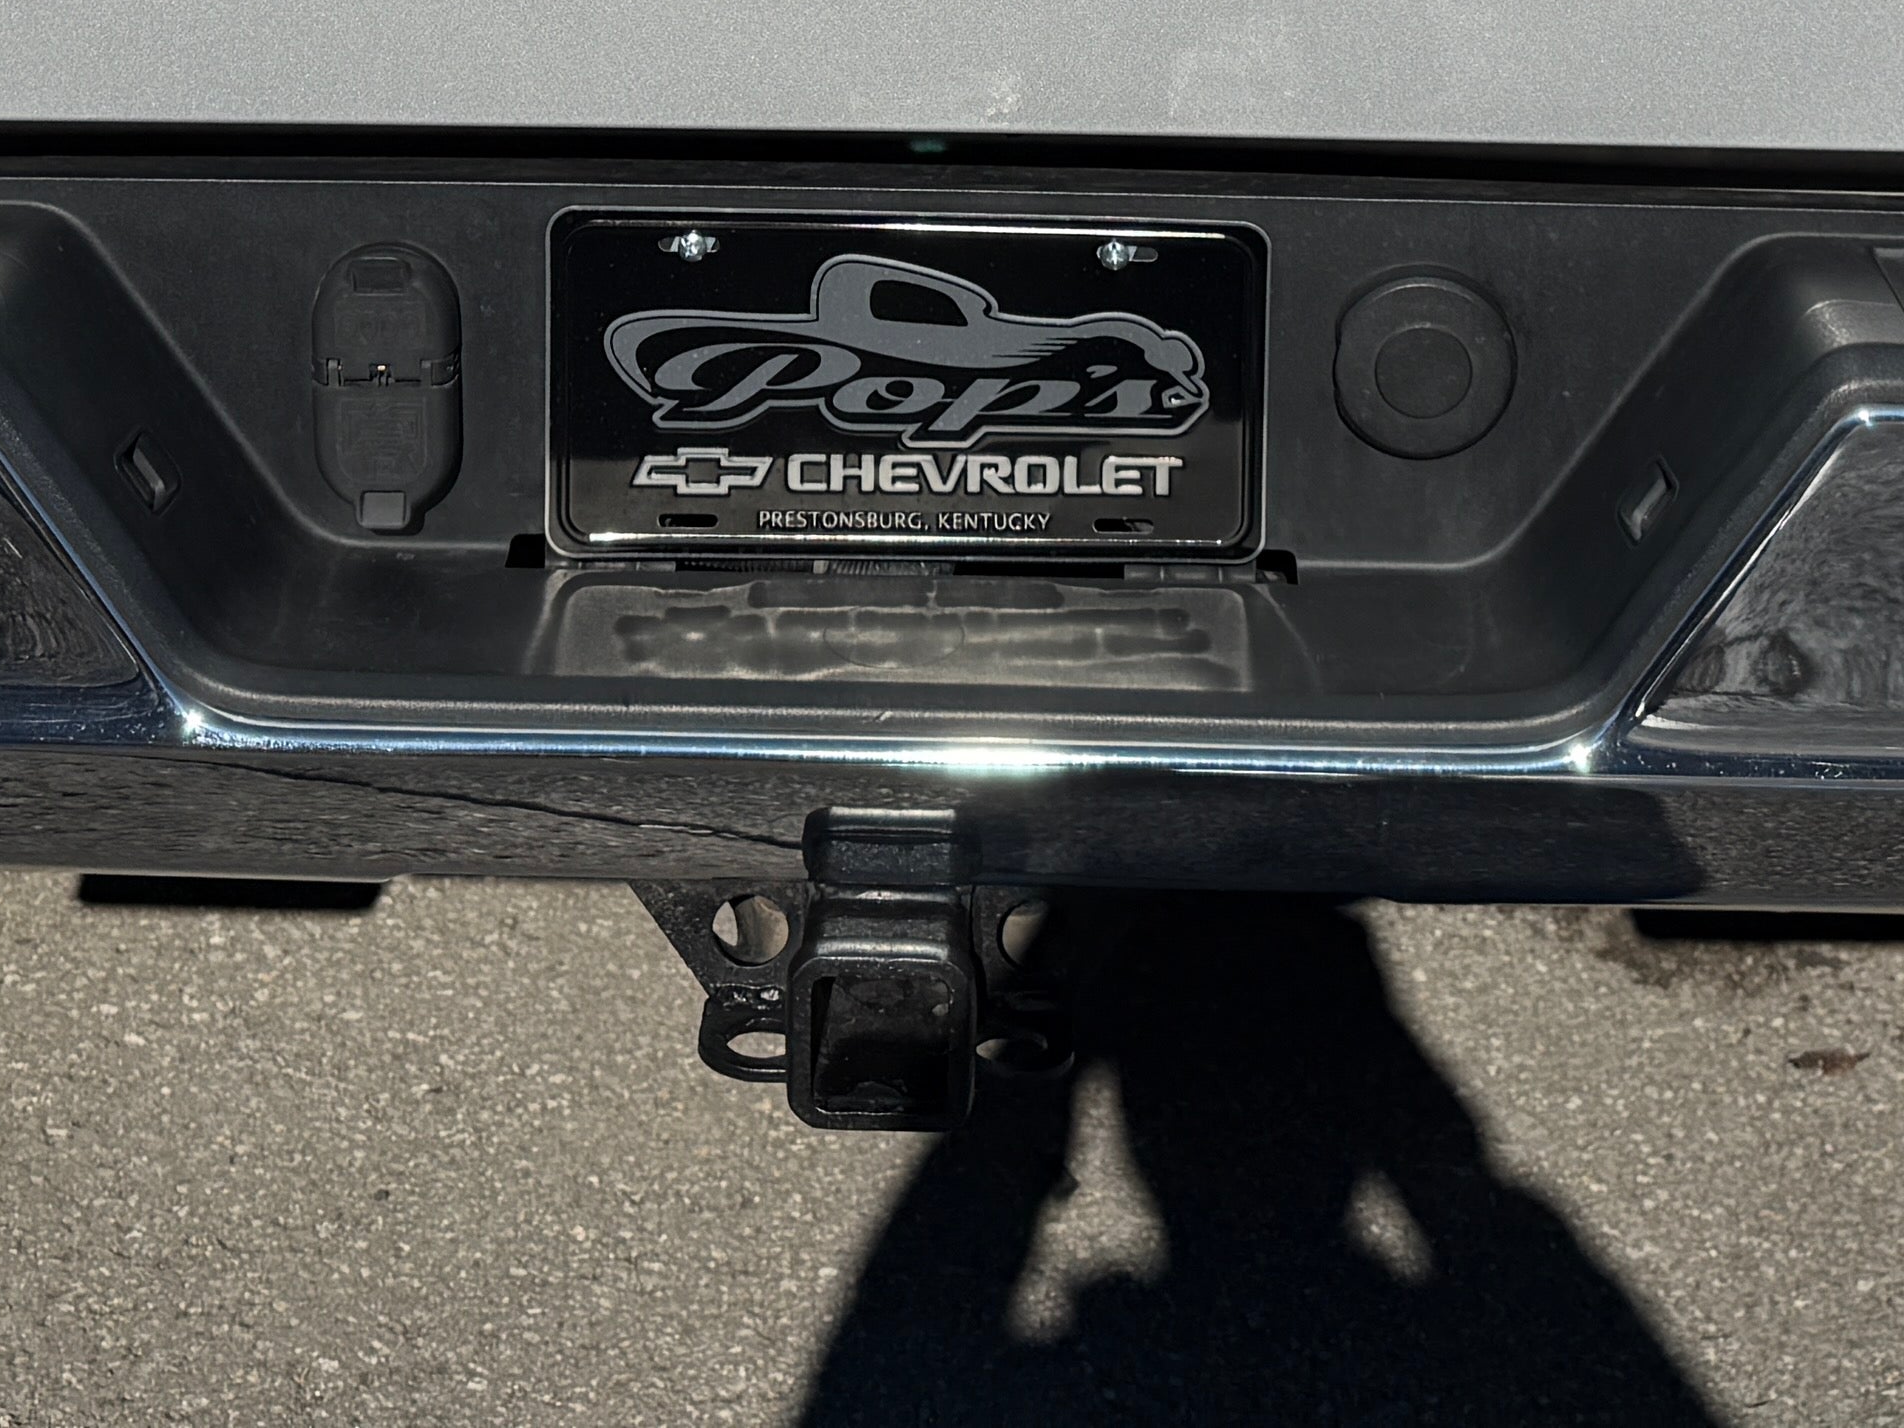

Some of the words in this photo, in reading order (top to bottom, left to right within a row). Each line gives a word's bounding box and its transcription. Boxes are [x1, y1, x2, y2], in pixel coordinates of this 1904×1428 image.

[654, 343, 1174, 432] Pop's
[786, 452, 1184, 497] CHEVROLET
[759, 510, 930, 531] PRESTONSBURG,
[938, 512, 1051, 531] KENTUCKY
